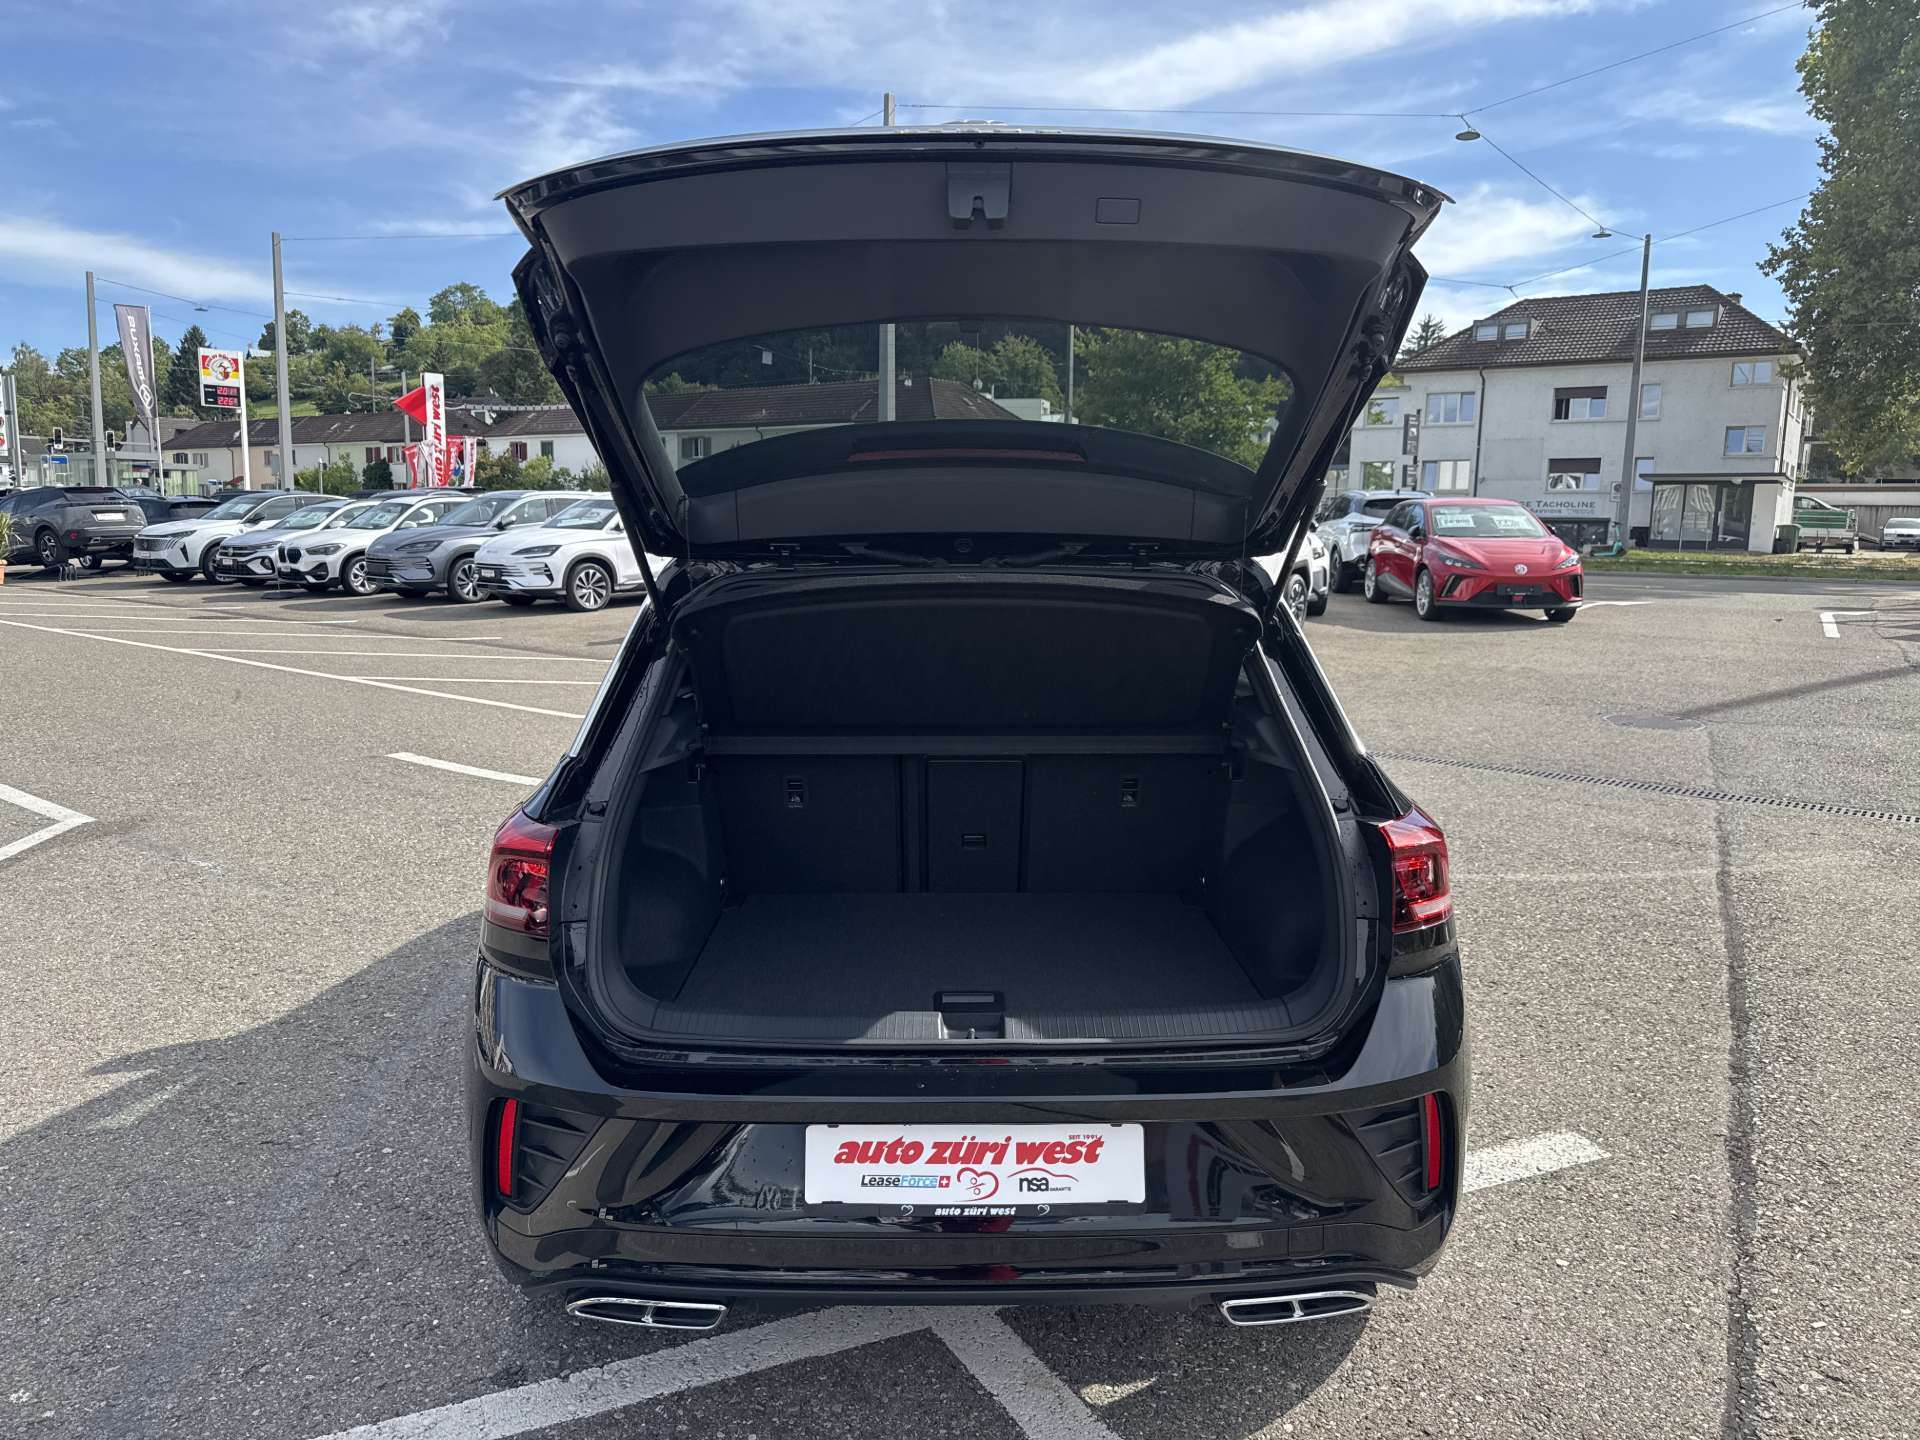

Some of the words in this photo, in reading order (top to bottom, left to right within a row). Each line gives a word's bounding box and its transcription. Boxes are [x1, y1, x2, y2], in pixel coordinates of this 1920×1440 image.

[1535, 500, 1597, 508] TACHOLINE
[833, 1135, 925, 1165] auto
[924, 1135, 1012, 1165] züri
[1015, 1134, 1105, 1165] west
[860, 1174, 939, 1188] LeaseForce
[1018, 1177, 1049, 1192] nsa
[934, 1207, 960, 1216] auto
[963, 1206, 988, 1216] züri
[990, 1206, 1017, 1216] west
